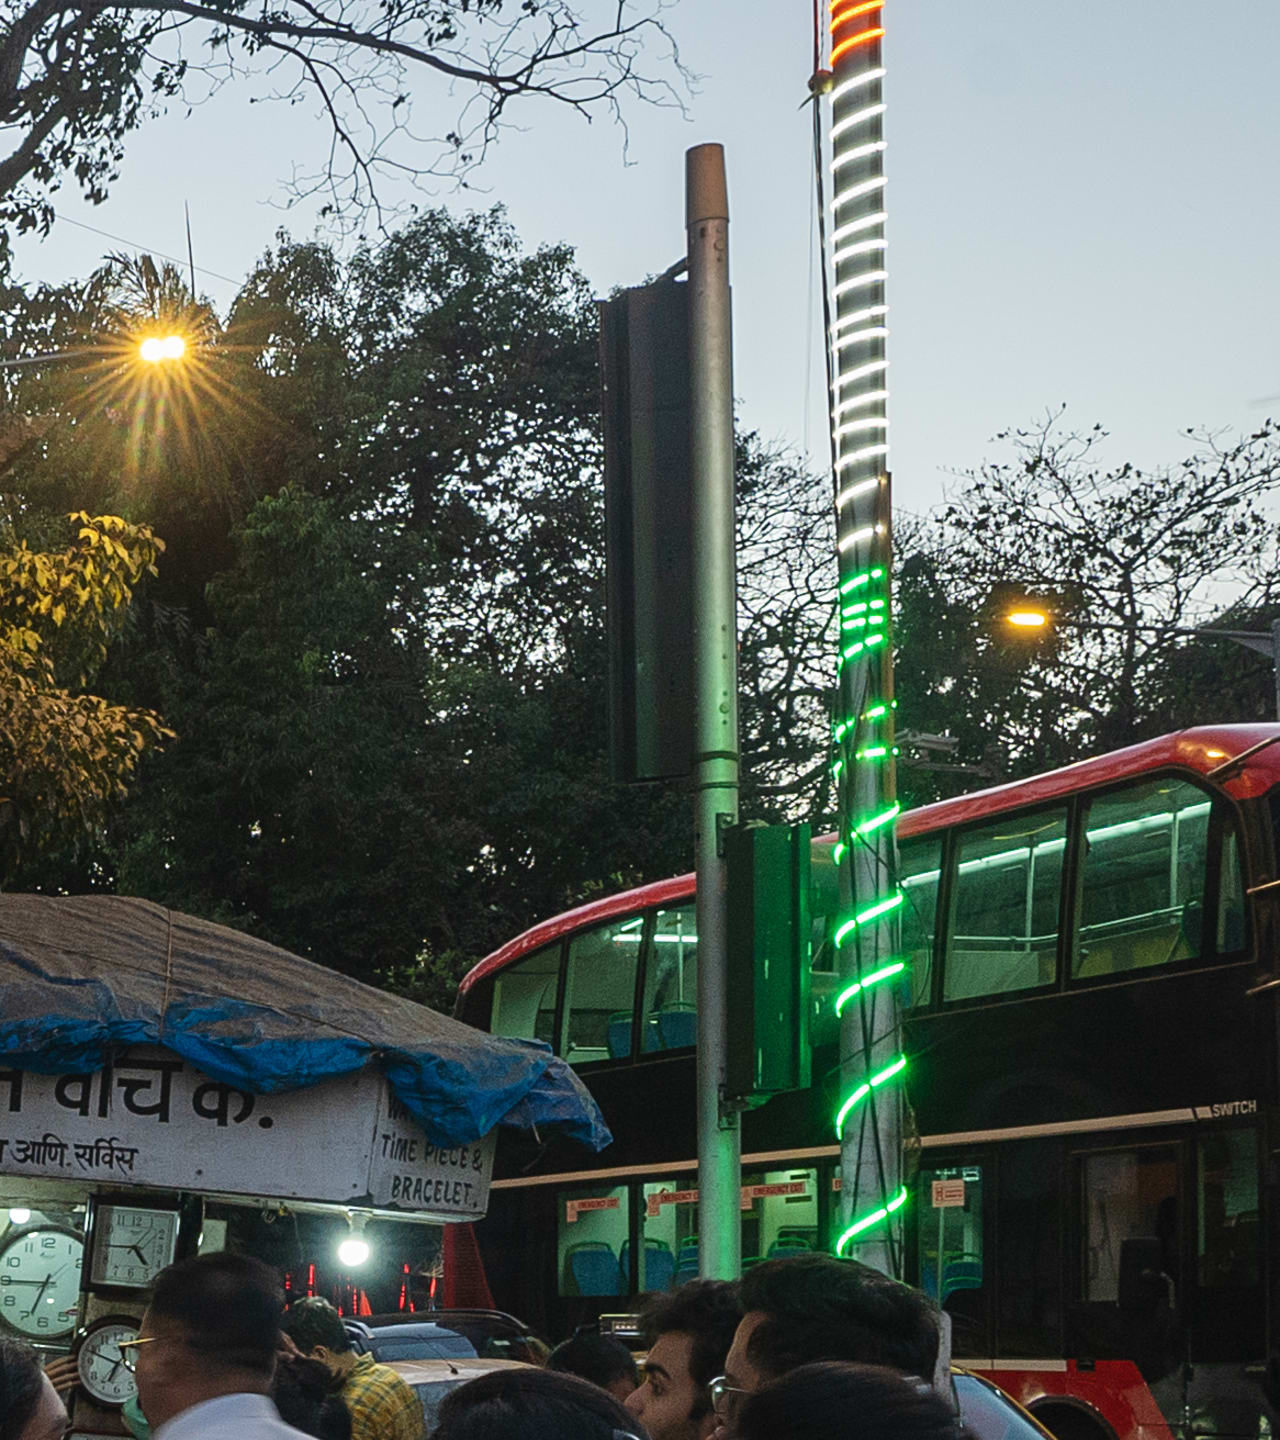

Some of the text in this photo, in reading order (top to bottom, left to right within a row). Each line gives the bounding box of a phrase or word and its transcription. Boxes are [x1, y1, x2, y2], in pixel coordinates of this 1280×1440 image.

[74, 1137, 139, 1172] सर्विस
[25, 1243, 34, 1254] 11
[41, 1238, 56, 1249] 12
[68, 1244, 72, 1255] 1
[7, 1256, 21, 1268] 10
[75, 1257, 83, 1269] 2
[0, 1275, 12, 1286] 9
[4, 1295, 16, 1307] 8
[20, 1310, 30, 1321] 7
[58, 1311, 70, 1323] 5
[37, 1316, 49, 1328] 6
